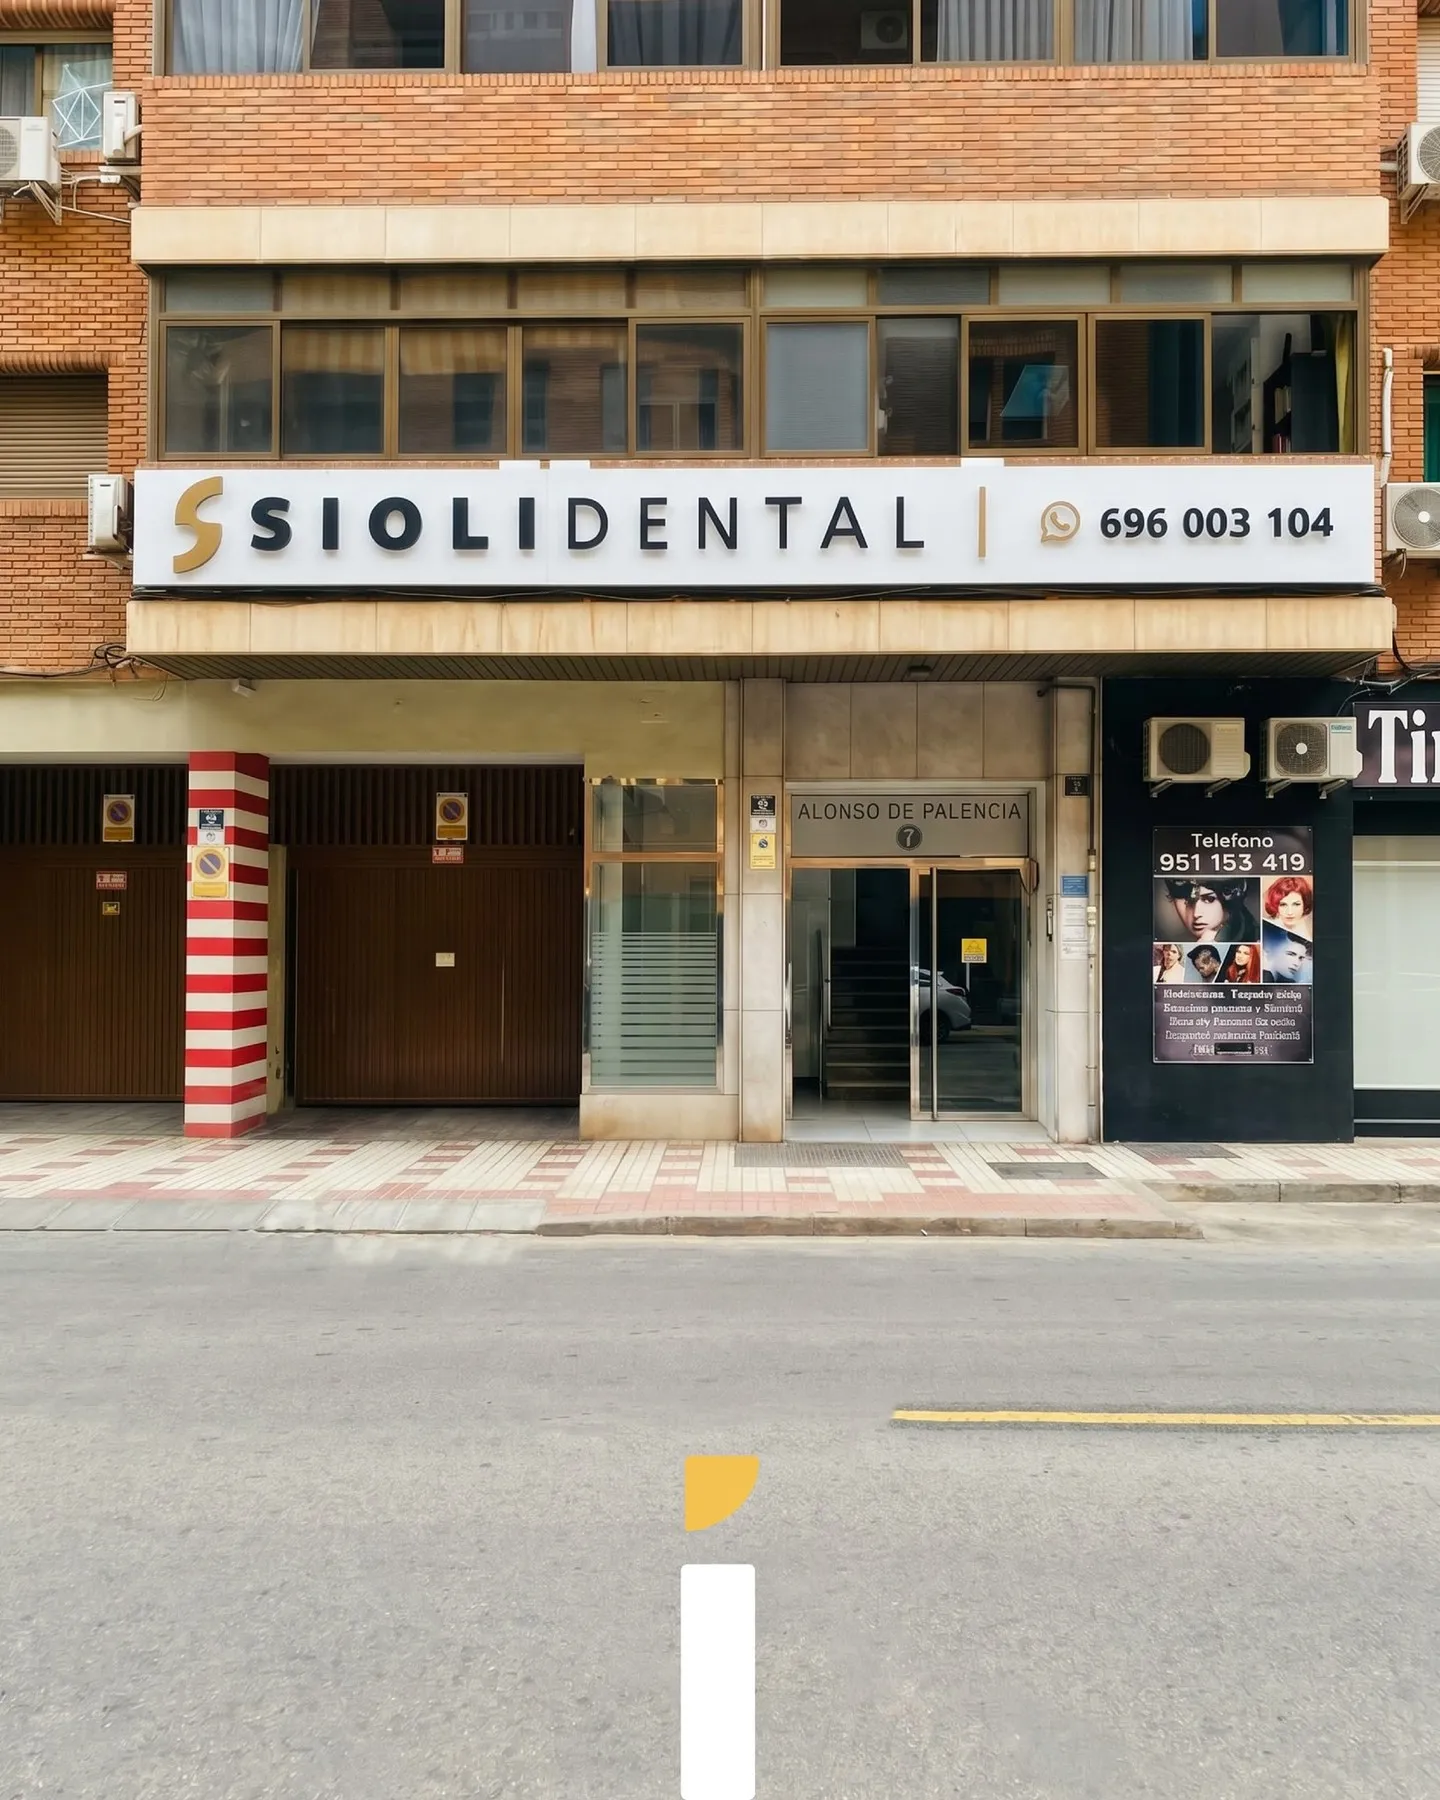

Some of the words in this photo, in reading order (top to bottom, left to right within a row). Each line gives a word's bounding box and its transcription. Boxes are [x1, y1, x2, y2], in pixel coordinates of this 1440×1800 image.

[1100, 507, 1168, 539] 696
[1183, 507, 1251, 539] 003
[1267, 507, 1334, 539] 104
[798, 802, 880, 820] ALONSO
[888, 802, 915, 820] DE
[923, 802, 1022, 820] PALENCIA
[1159, 853, 1200, 872] 951
[1210, 853, 1253, 872] 153
[1262, 853, 1305, 872] 419
